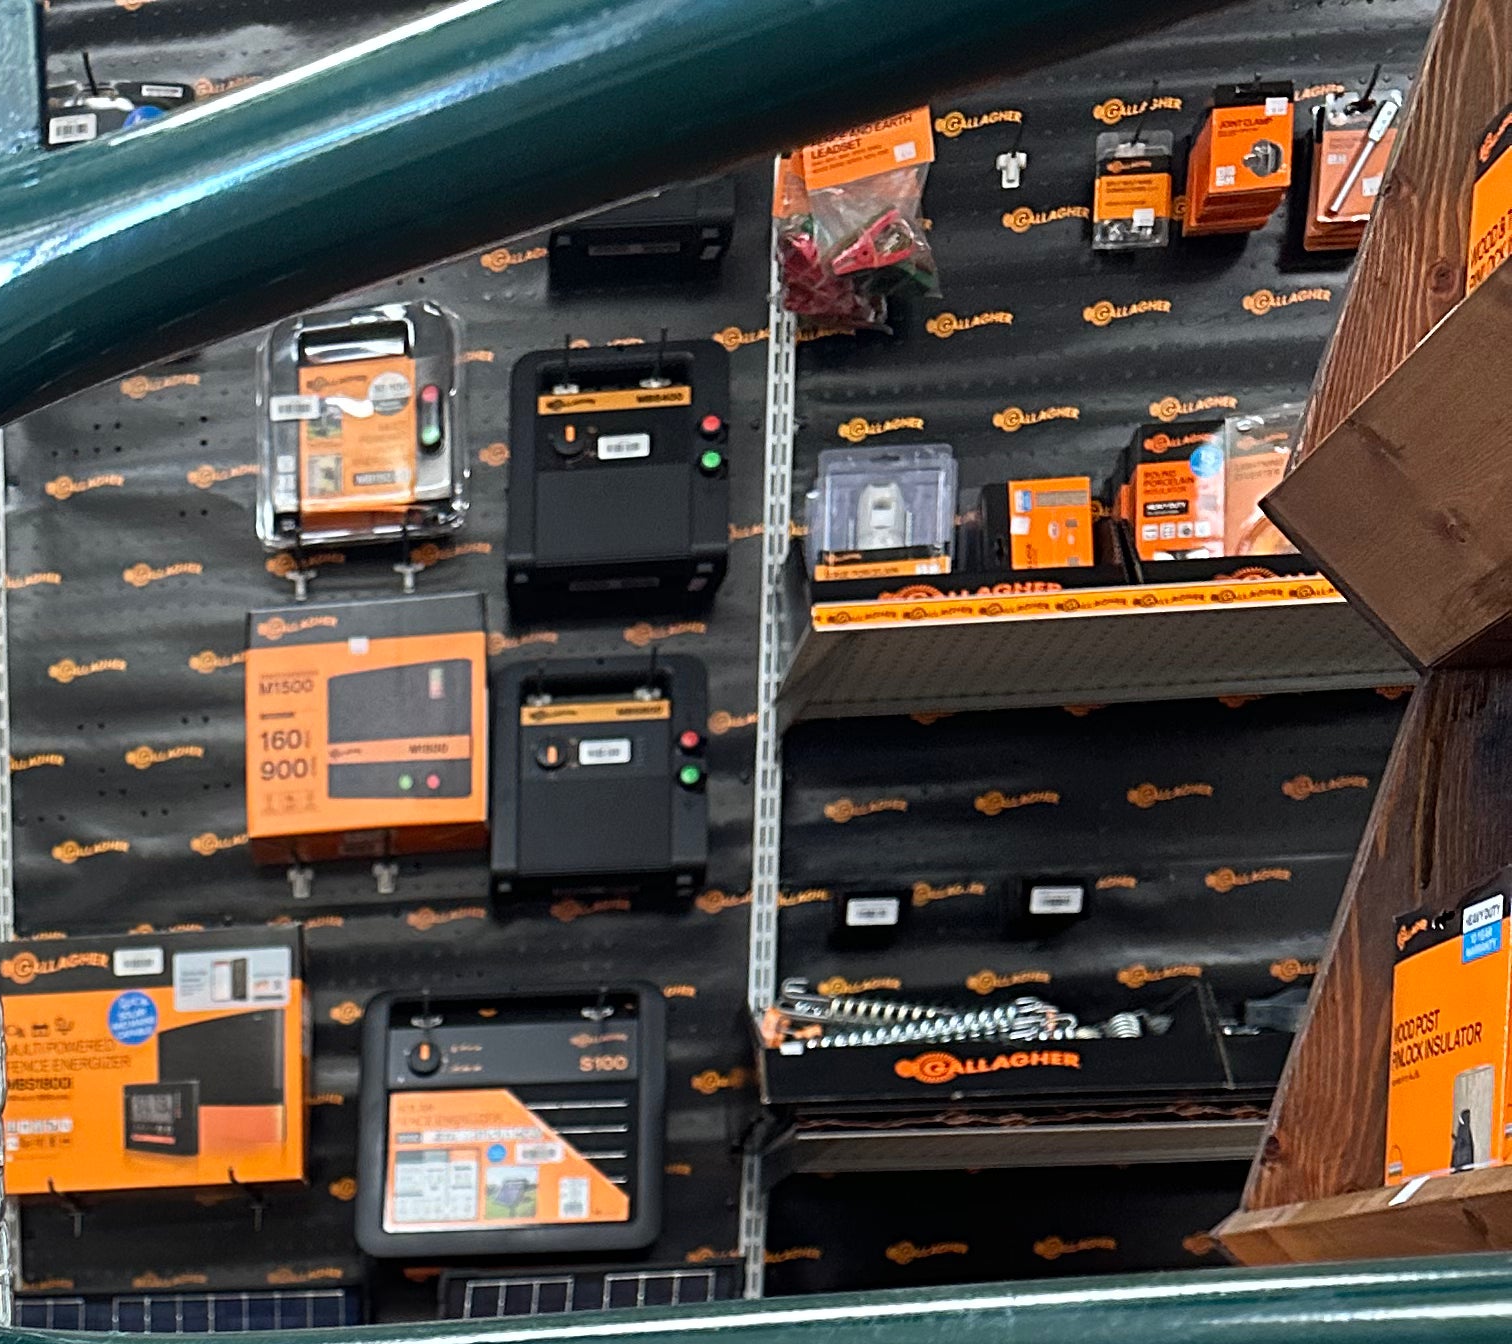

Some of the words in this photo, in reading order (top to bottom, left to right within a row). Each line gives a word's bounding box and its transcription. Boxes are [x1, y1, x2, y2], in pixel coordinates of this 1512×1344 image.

[810, 138, 862, 159] LEADSET
[260, 728, 302, 752] 160
[260, 757, 309, 782] 900
[17, 953, 109, 978] GALLAGHER
[1416, 1009, 1440, 1036] POST
[1425, 1022, 1483, 1058] INSULATOR
[579, 1055, 628, 1071] S100
[926, 1051, 1081, 1083] GALLAGHER
